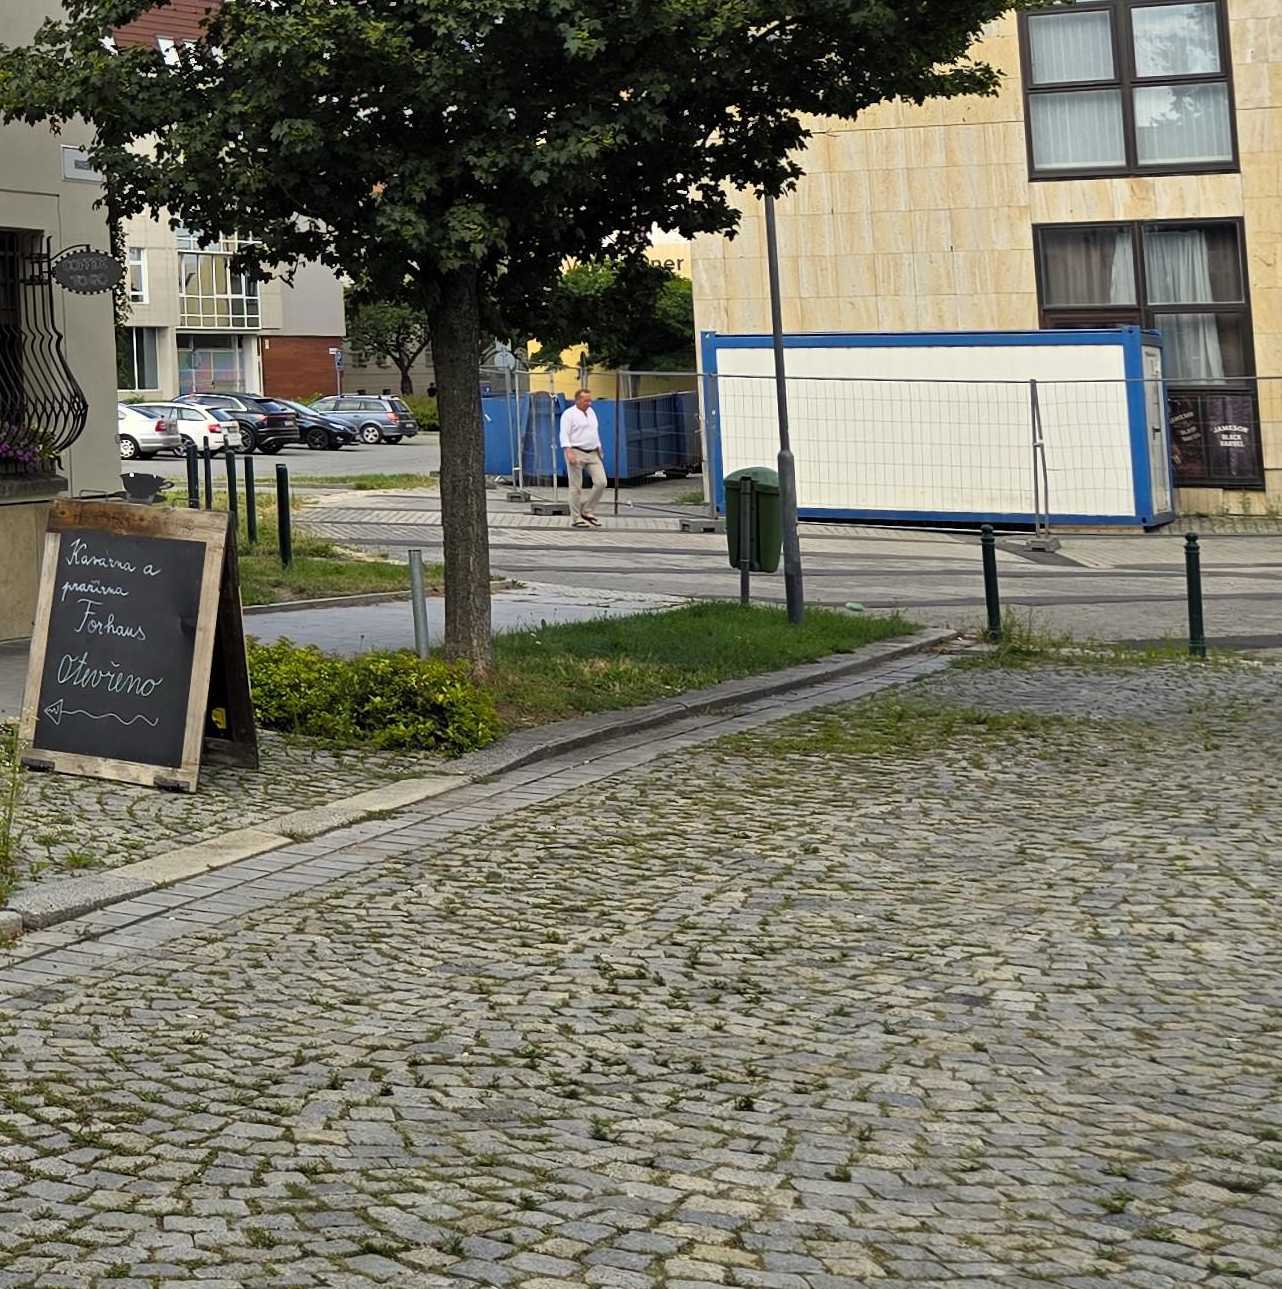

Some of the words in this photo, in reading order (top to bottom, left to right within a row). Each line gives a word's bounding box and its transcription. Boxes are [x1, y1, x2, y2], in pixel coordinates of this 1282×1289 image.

[1213, 424, 1249, 433] JAMESON
[142, 563, 162, 577] a
[74, 598, 147, 642] Forhaus
[57, 651, 164, 697] Otevřeno
